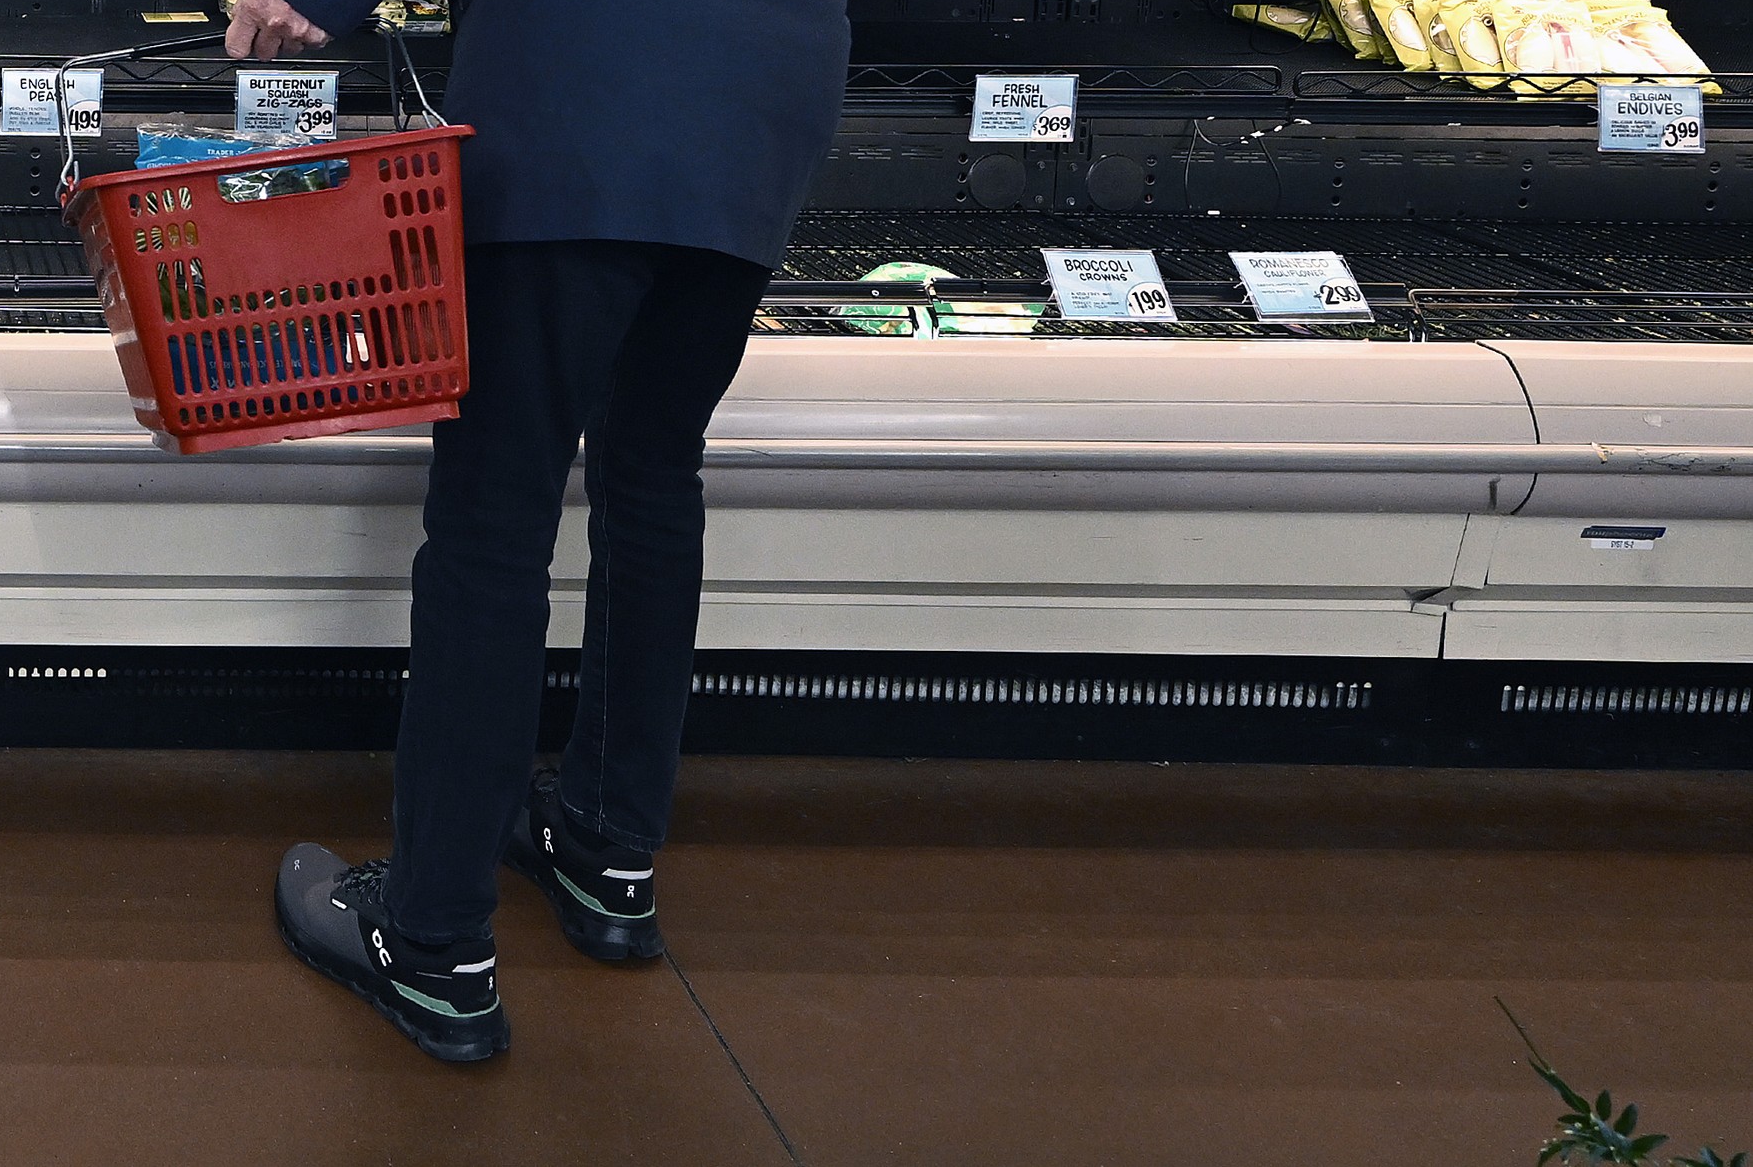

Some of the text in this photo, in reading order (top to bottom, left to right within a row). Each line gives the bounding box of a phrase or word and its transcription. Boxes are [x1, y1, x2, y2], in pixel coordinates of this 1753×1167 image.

[250, 79, 325, 90] BUTTERNUT
[1004, 83, 1039, 94] FRESH
[267, 89, 309, 98] SQUASH
[1630, 93, 1672, 102] BELGIAN
[257, 98, 322, 108] ZIG-ZAGS
[992, 95, 1048, 108] FENNEL
[1618, 102, 1683, 115] ENDIVES
[1064, 259, 1133, 273] BROCCOLI
[1249, 259, 1329, 268] ROMANESCO
[1079, 273, 1128, 282] CROWNS
[1264, 270, 1326, 278] CAULIFLOWER
